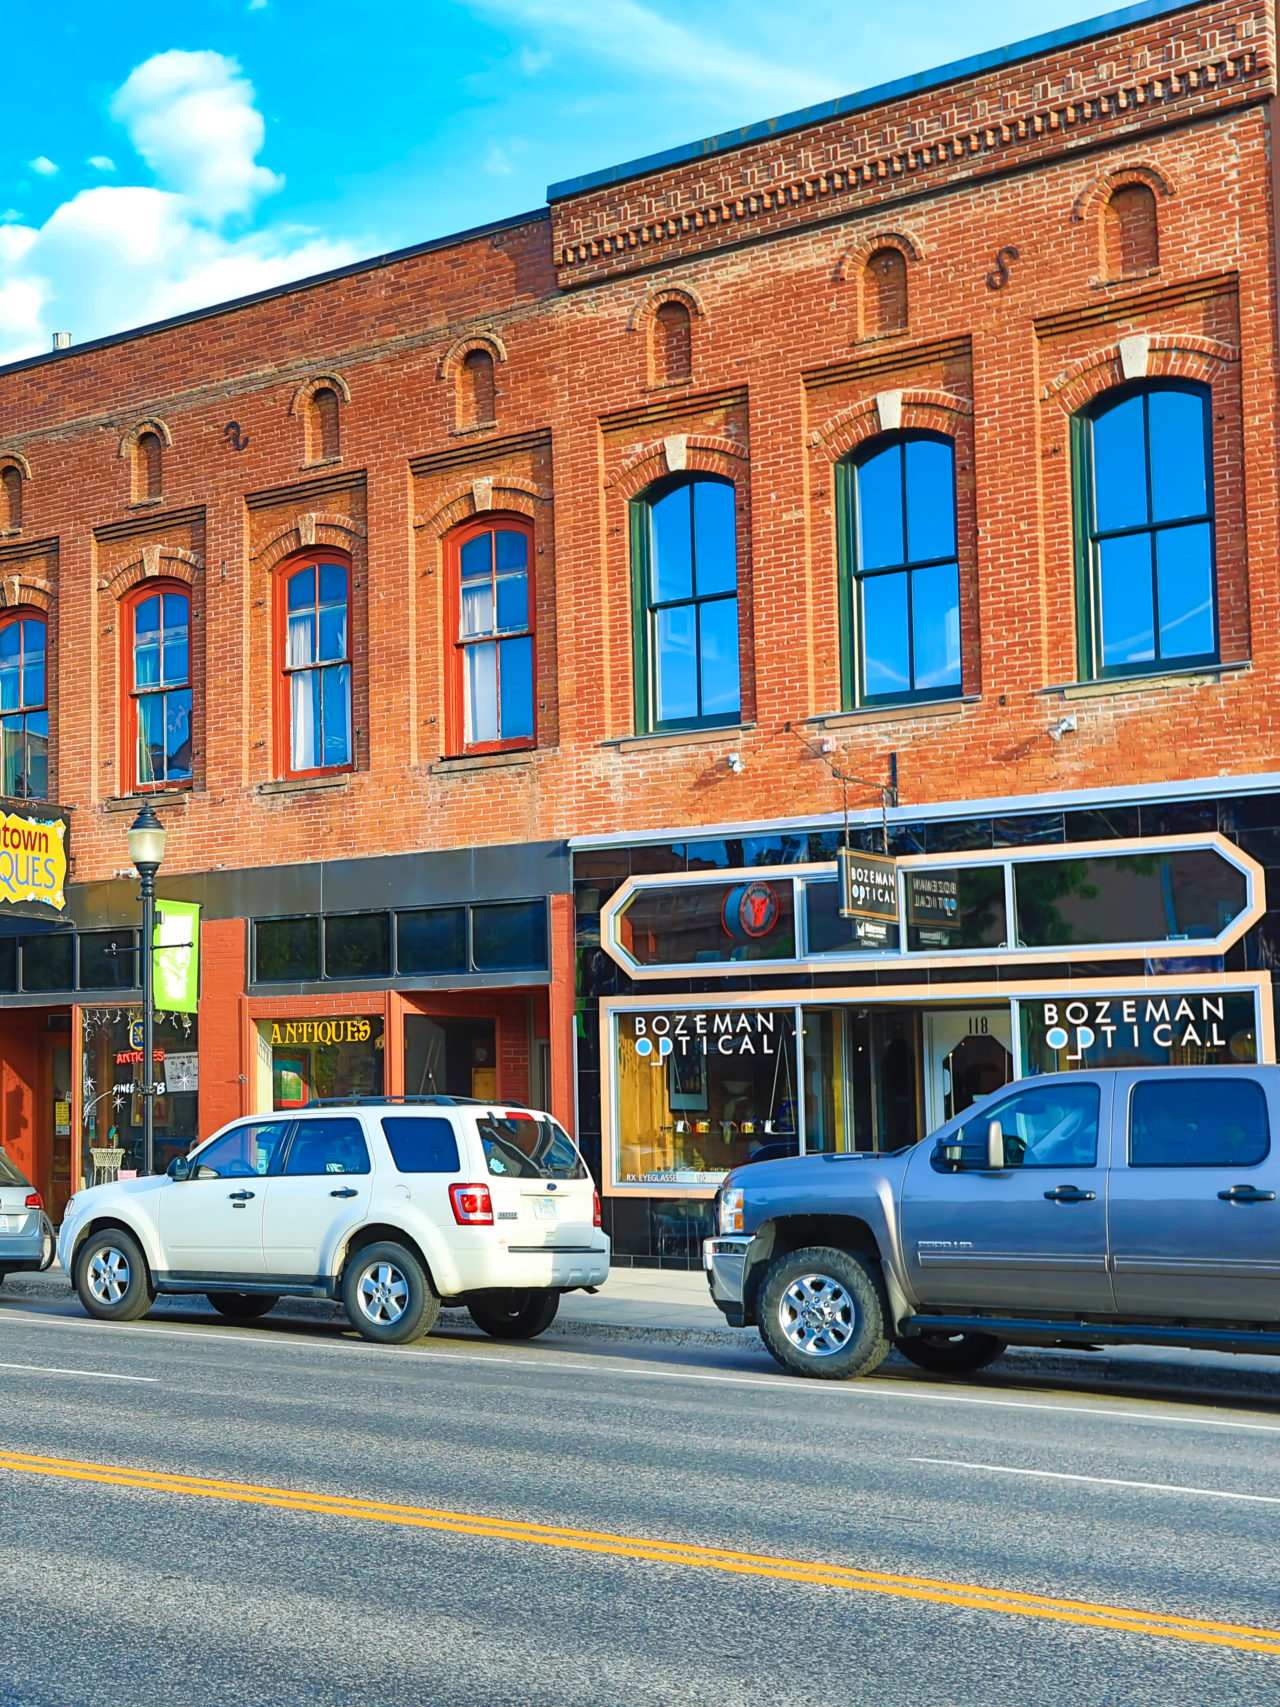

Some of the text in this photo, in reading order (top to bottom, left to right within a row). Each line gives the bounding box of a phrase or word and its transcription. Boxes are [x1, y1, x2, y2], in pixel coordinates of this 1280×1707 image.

[851, 867, 895, 886] BOZEMAN
[852, 884, 896, 905] OPTICAL
[1043, 997, 1224, 1026] BOZEMAN
[270, 1019, 371, 1046] ANTIQUES
[635, 1012, 774, 1036] BOZEMAN
[969, 1016, 988, 1035] 118
[635, 1034, 774, 1066] OPTICAL
[1046, 1023, 1226, 1061] OPTICAL
[117, 1050, 165, 1064] ANTIES
[113, 1083, 135, 1096] SINCE
[626, 1173, 681, 1183] RX EYEGLASSE
